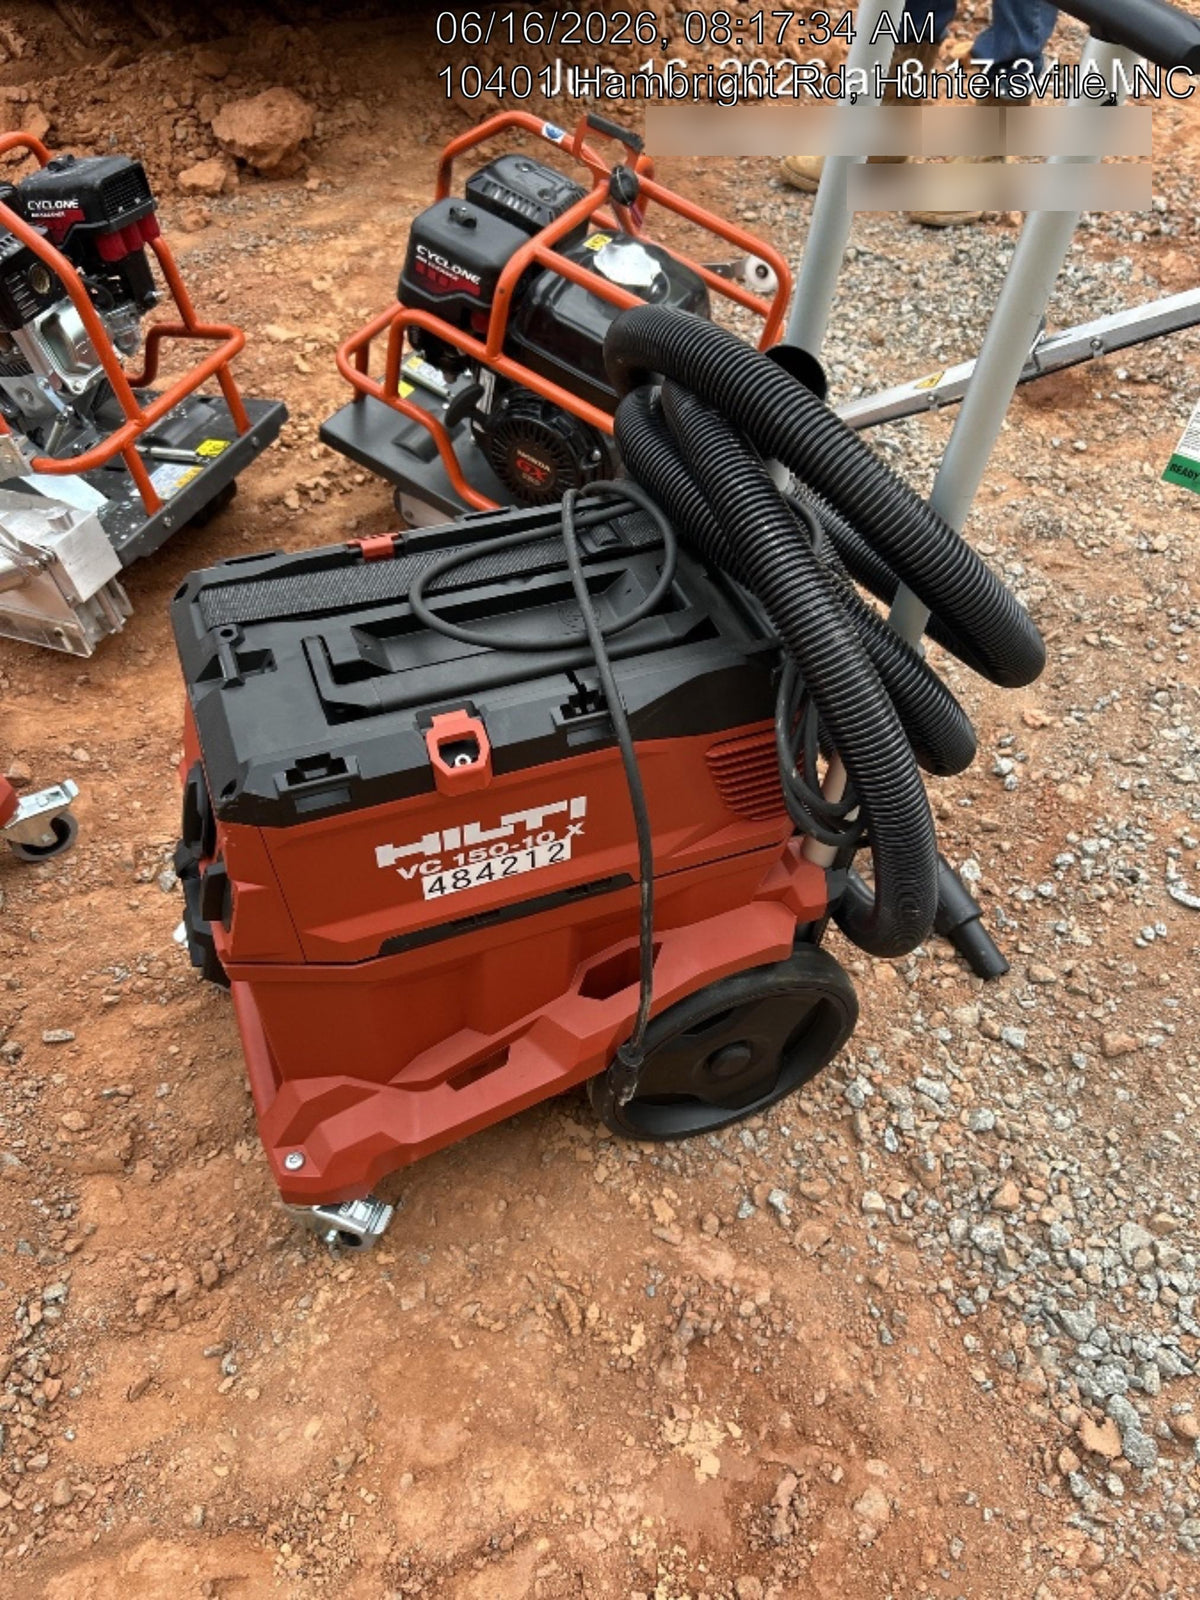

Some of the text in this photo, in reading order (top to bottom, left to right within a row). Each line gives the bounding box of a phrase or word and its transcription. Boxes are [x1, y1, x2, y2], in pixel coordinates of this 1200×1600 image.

[27, 199, 79, 211] CYCLONE
[416, 244, 482, 285] CYCLONE
[1170, 463, 1200, 481] READY
[375, 796, 587, 868] HILTI
[396, 821, 586, 881] VC 150-10 X
[427, 842, 565, 896] 484212
